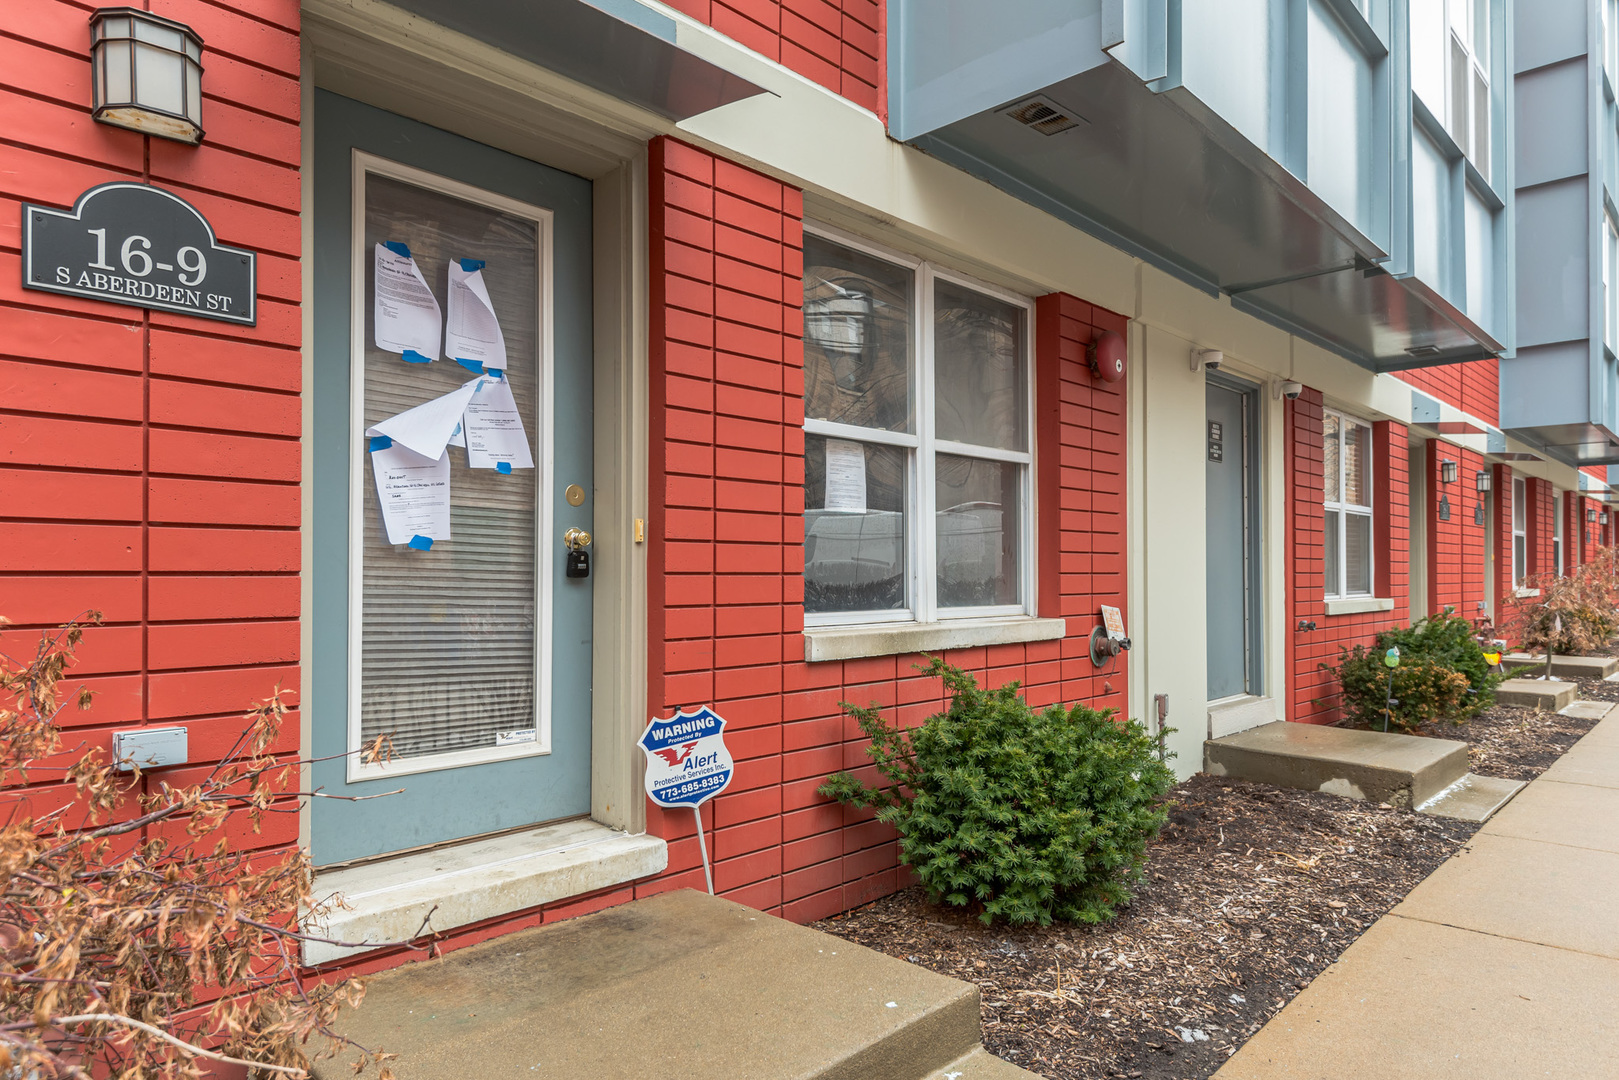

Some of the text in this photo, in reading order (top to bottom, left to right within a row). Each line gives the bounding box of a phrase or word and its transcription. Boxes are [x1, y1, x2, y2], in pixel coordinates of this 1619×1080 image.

[88, 228, 207, 287] 16-9
[56, 266, 232, 312] S ABERDEEN ST
[651, 716, 715, 741] WARNING
[667, 731, 702, 744] Protected By
[683, 751, 718, 772] Alert
[653, 763, 727, 788] Protective Services Inc.
